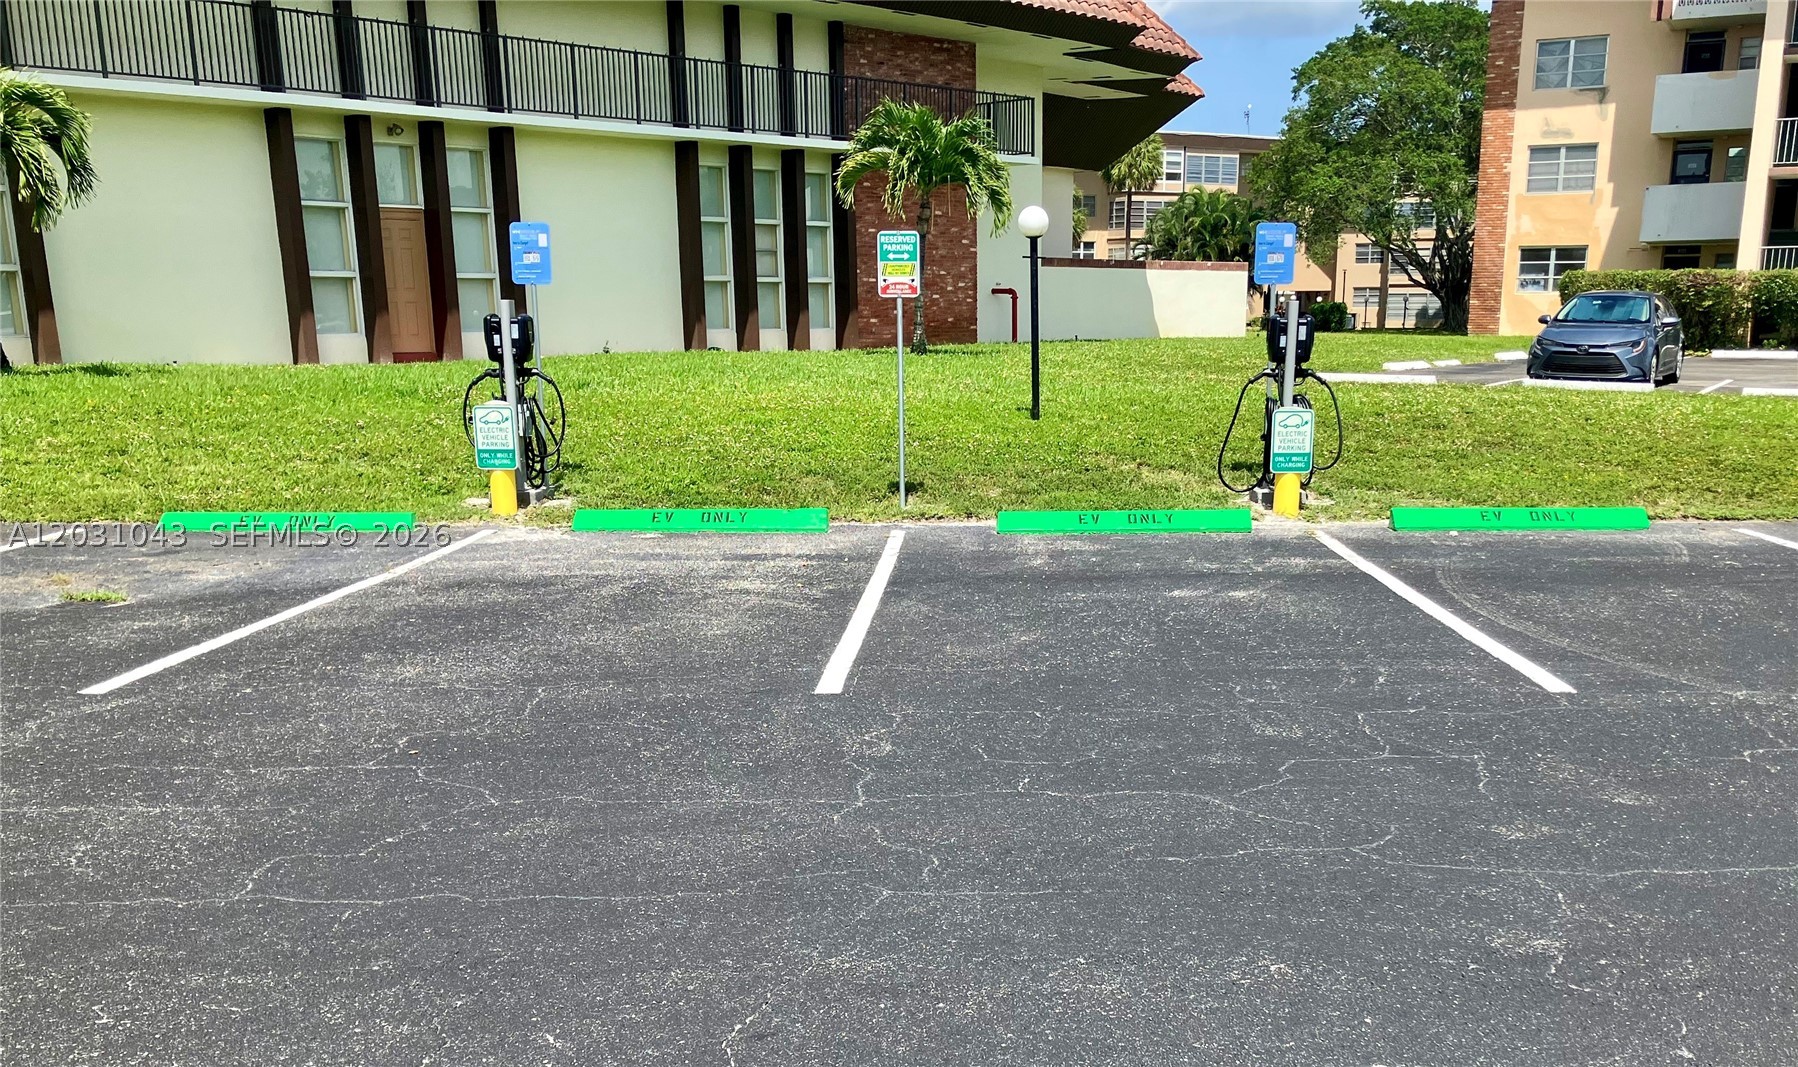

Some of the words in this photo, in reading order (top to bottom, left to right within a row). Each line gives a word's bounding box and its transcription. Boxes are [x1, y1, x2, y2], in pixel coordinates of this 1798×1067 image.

[883, 244, 914, 252] PARKING
[241, 515, 262, 527] EV
[289, 515, 336, 528] ONLY
[652, 512, 674, 523] EV
[701, 512, 748, 523] ONLY
[1079, 514, 1100, 524] EV
[1127, 513, 1173, 524] ONLY
[1480, 511, 1502, 522] EV
[1529, 511, 1575, 522] ONLY
